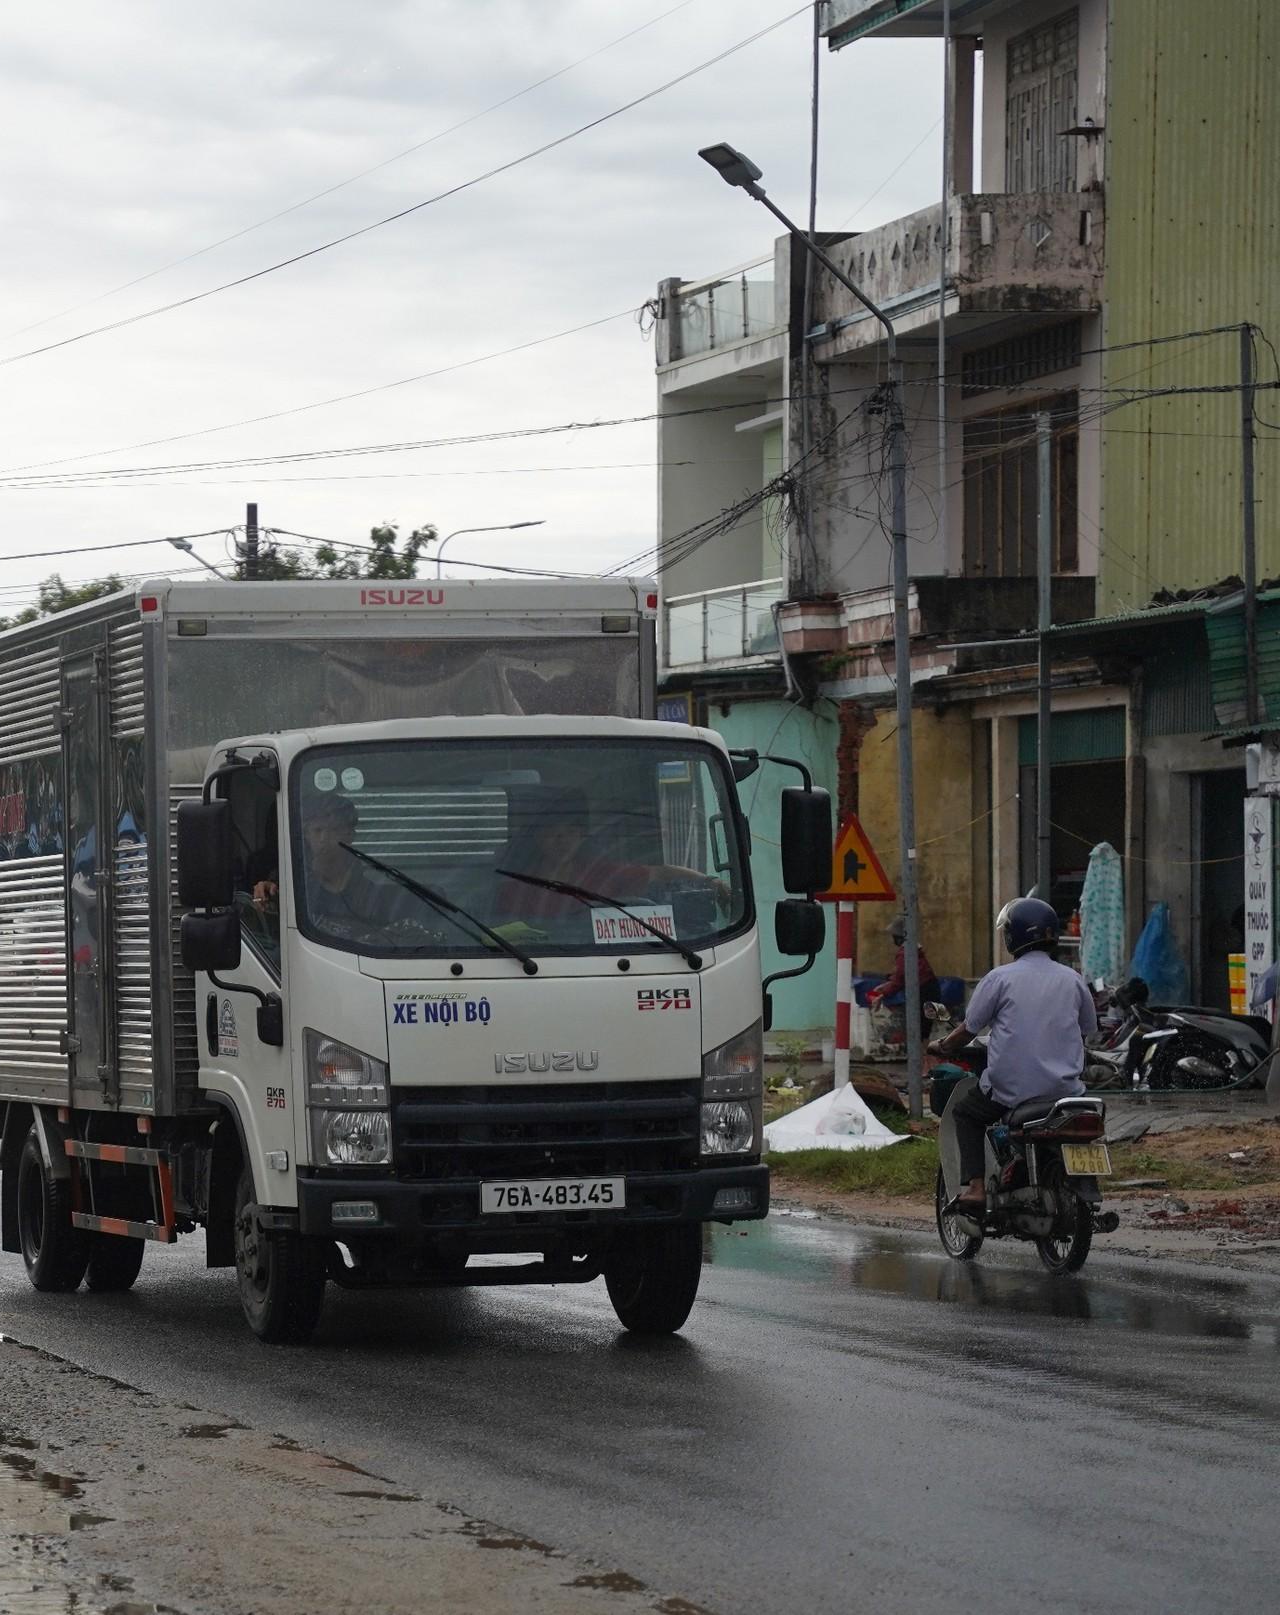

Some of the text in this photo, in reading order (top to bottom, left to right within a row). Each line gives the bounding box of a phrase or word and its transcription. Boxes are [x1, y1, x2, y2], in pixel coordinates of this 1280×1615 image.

[360, 589, 444, 605] ISUZU
[1251, 942, 1265, 961] GPP
[637, 989, 690, 1000] QKR
[393, 996, 490, 1026] XE NỘI BỘ
[638, 1000, 691, 1011] 270
[494, 1051, 599, 1074] ISUZU
[266, 1087, 285, 1098] QKR
[266, 1098, 286, 1109] 270
[494, 1183, 614, 1208] 76A-483.45
